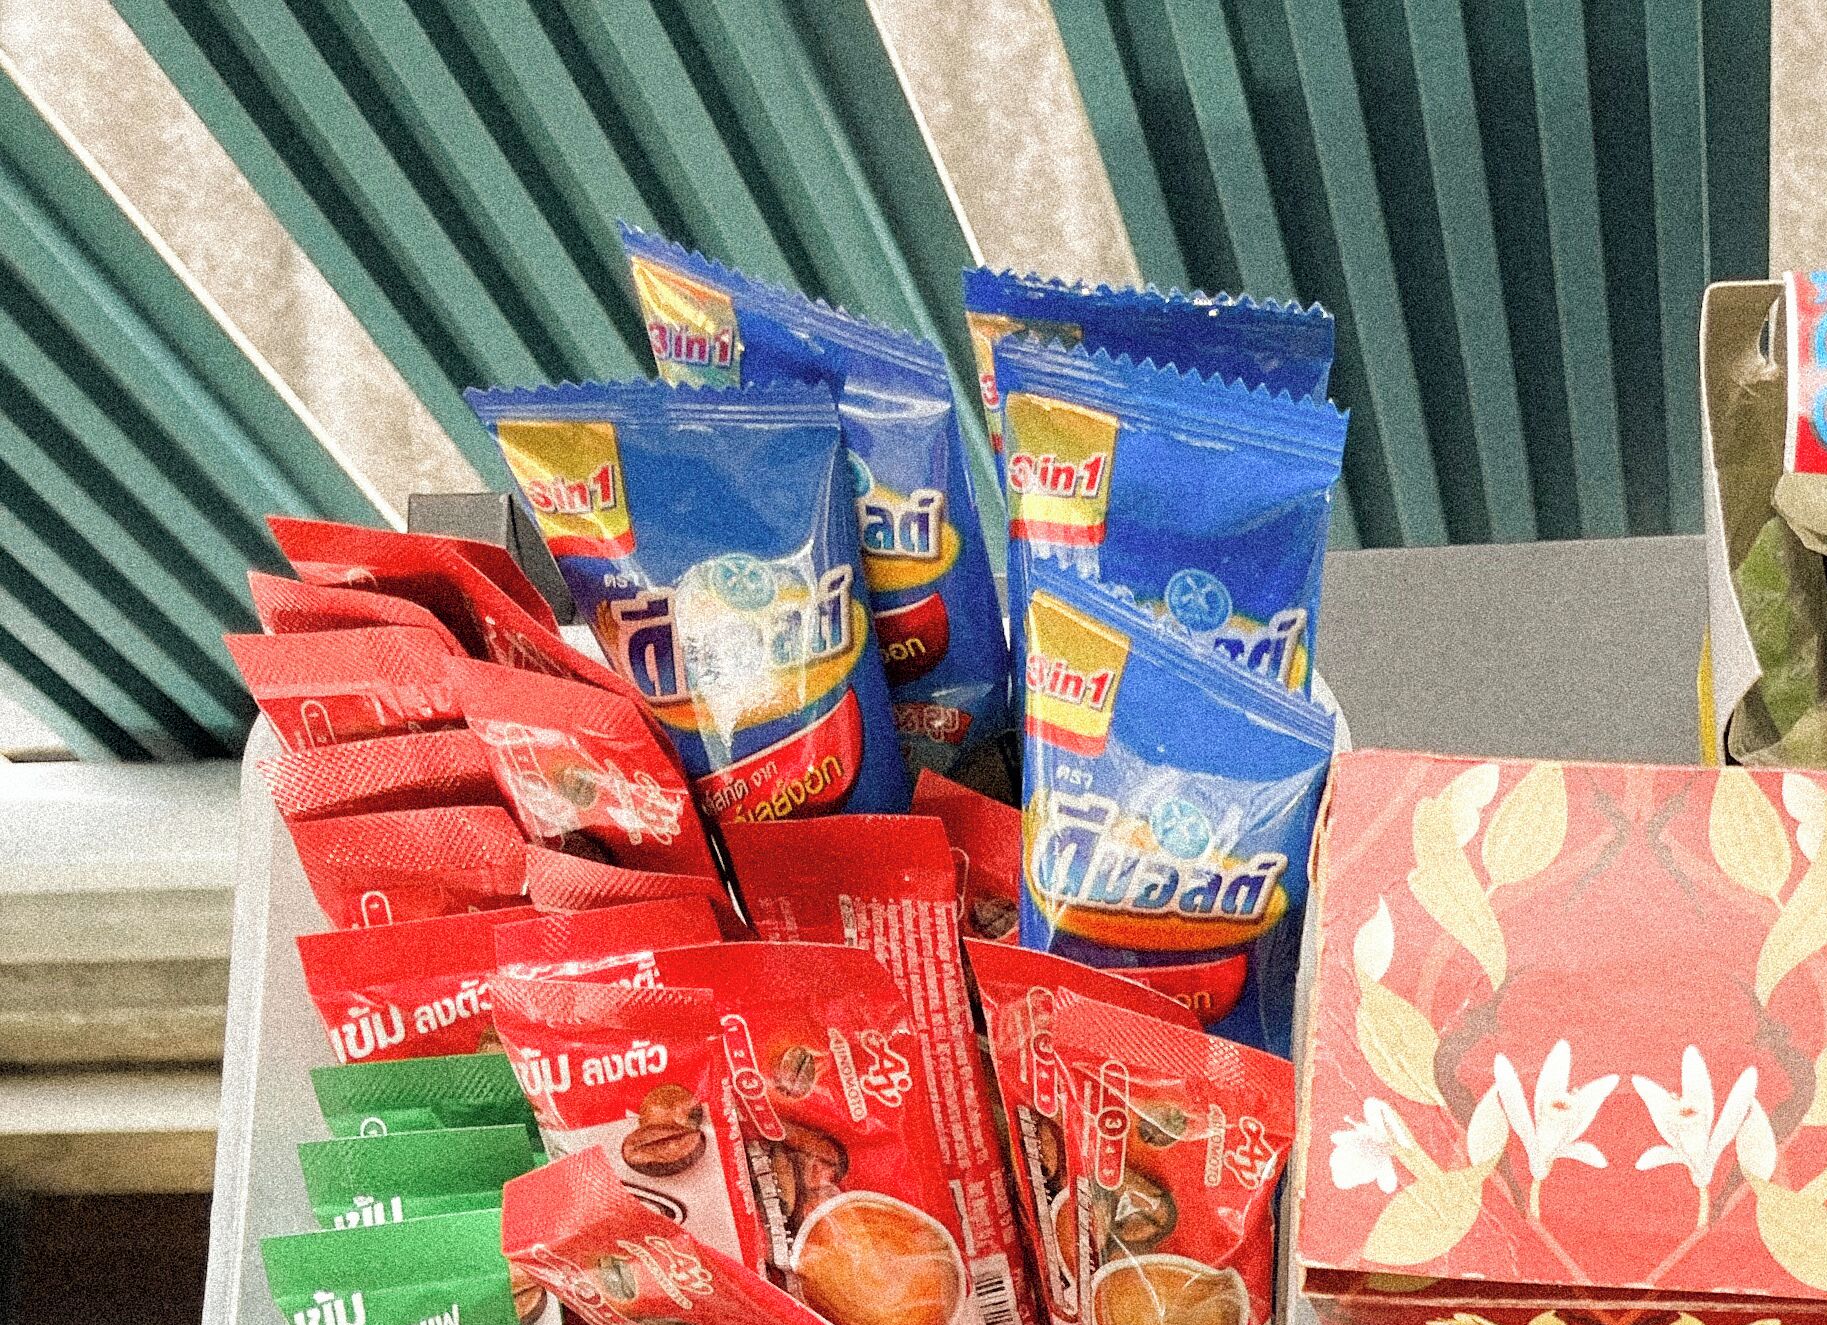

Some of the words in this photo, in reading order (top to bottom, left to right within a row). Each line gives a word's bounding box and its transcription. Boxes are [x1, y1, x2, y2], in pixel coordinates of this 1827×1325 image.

[648, 322, 737, 366] 3in1
[530, 466, 616, 514] 3in1
[1009, 452, 1106, 498] 3in1
[1027, 653, 1115, 711] 3in1
[581, 1040, 668, 1086] ลงตัว
